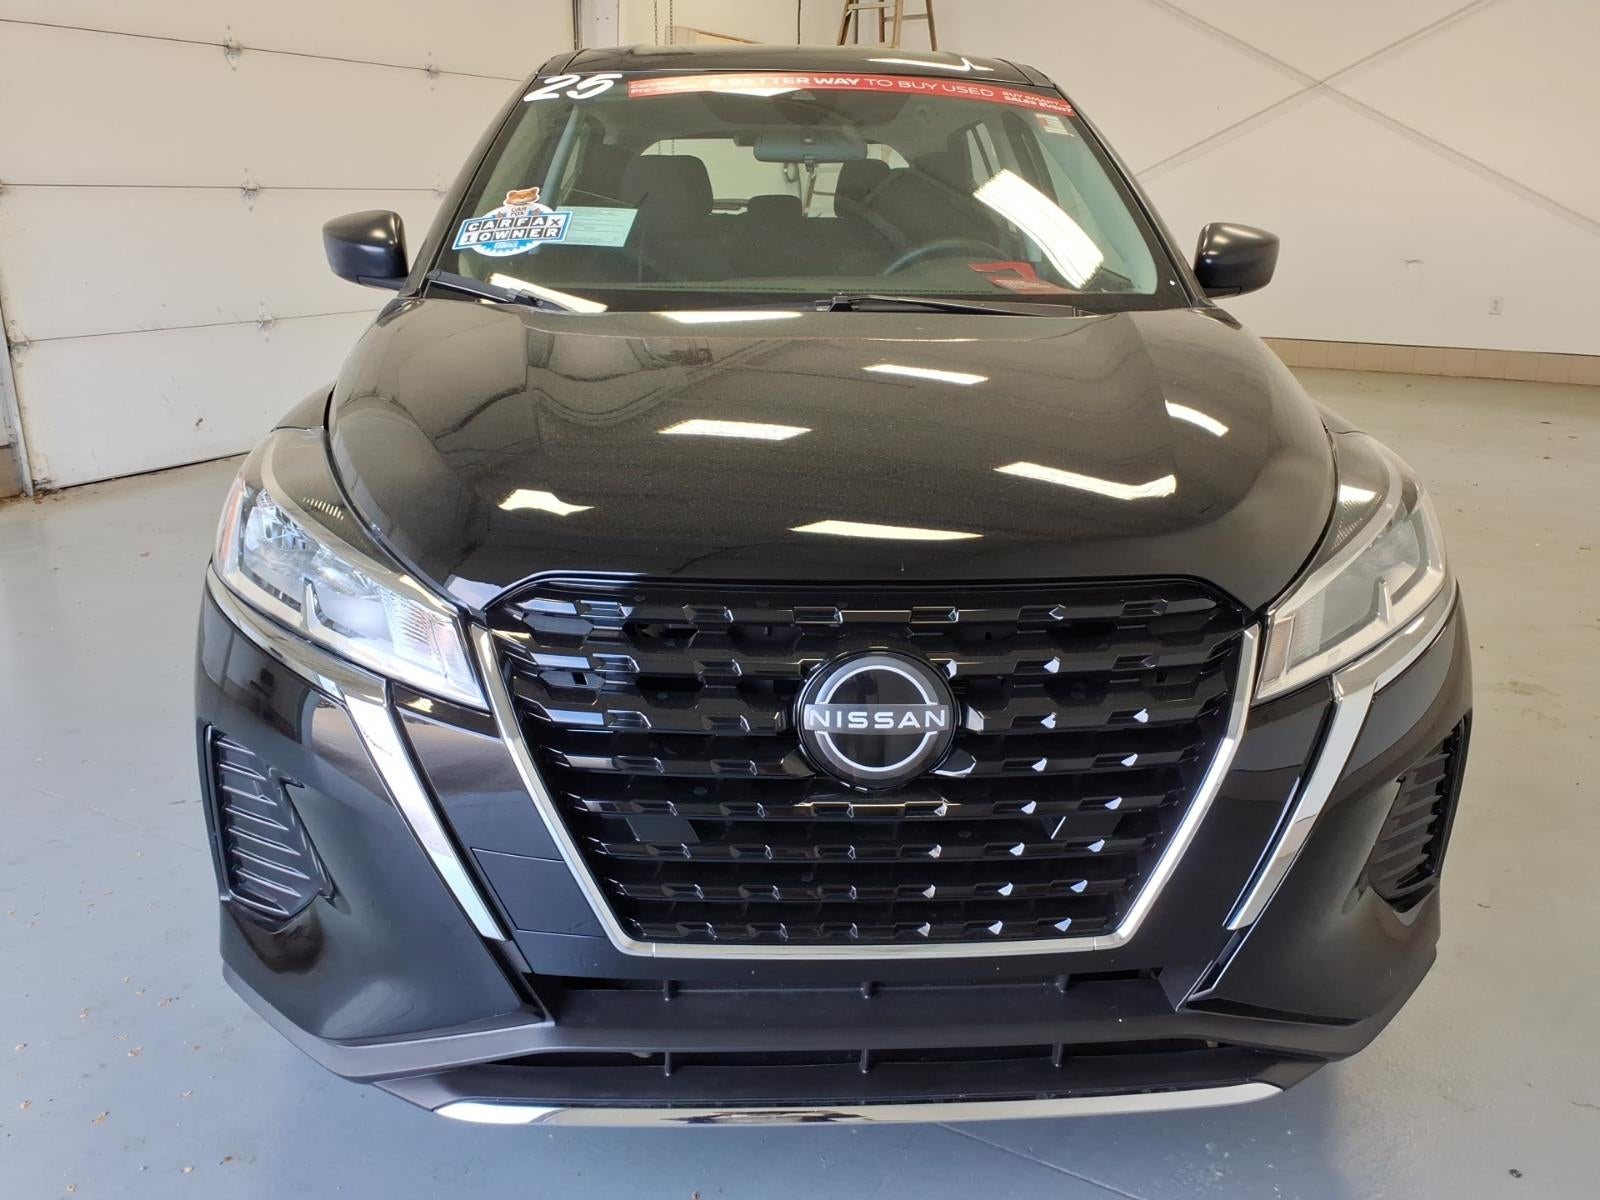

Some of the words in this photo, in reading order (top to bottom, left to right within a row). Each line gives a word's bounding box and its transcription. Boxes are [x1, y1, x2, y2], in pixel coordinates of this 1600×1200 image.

[523, 73, 623, 102] 25
[813, 76, 860, 86] WAY
[863, 78, 893, 87] TO
[898, 80, 938, 91] BUY
[942, 83, 994, 97] USED
[1004, 95, 1037, 106] SALES
[1038, 102, 1073, 113] EVENT
[467, 216, 561, 232] CARFAX
[464, 234, 472, 243] 1
[479, 228, 558, 241] OWNER
[809, 709, 945, 729] NISSAN
